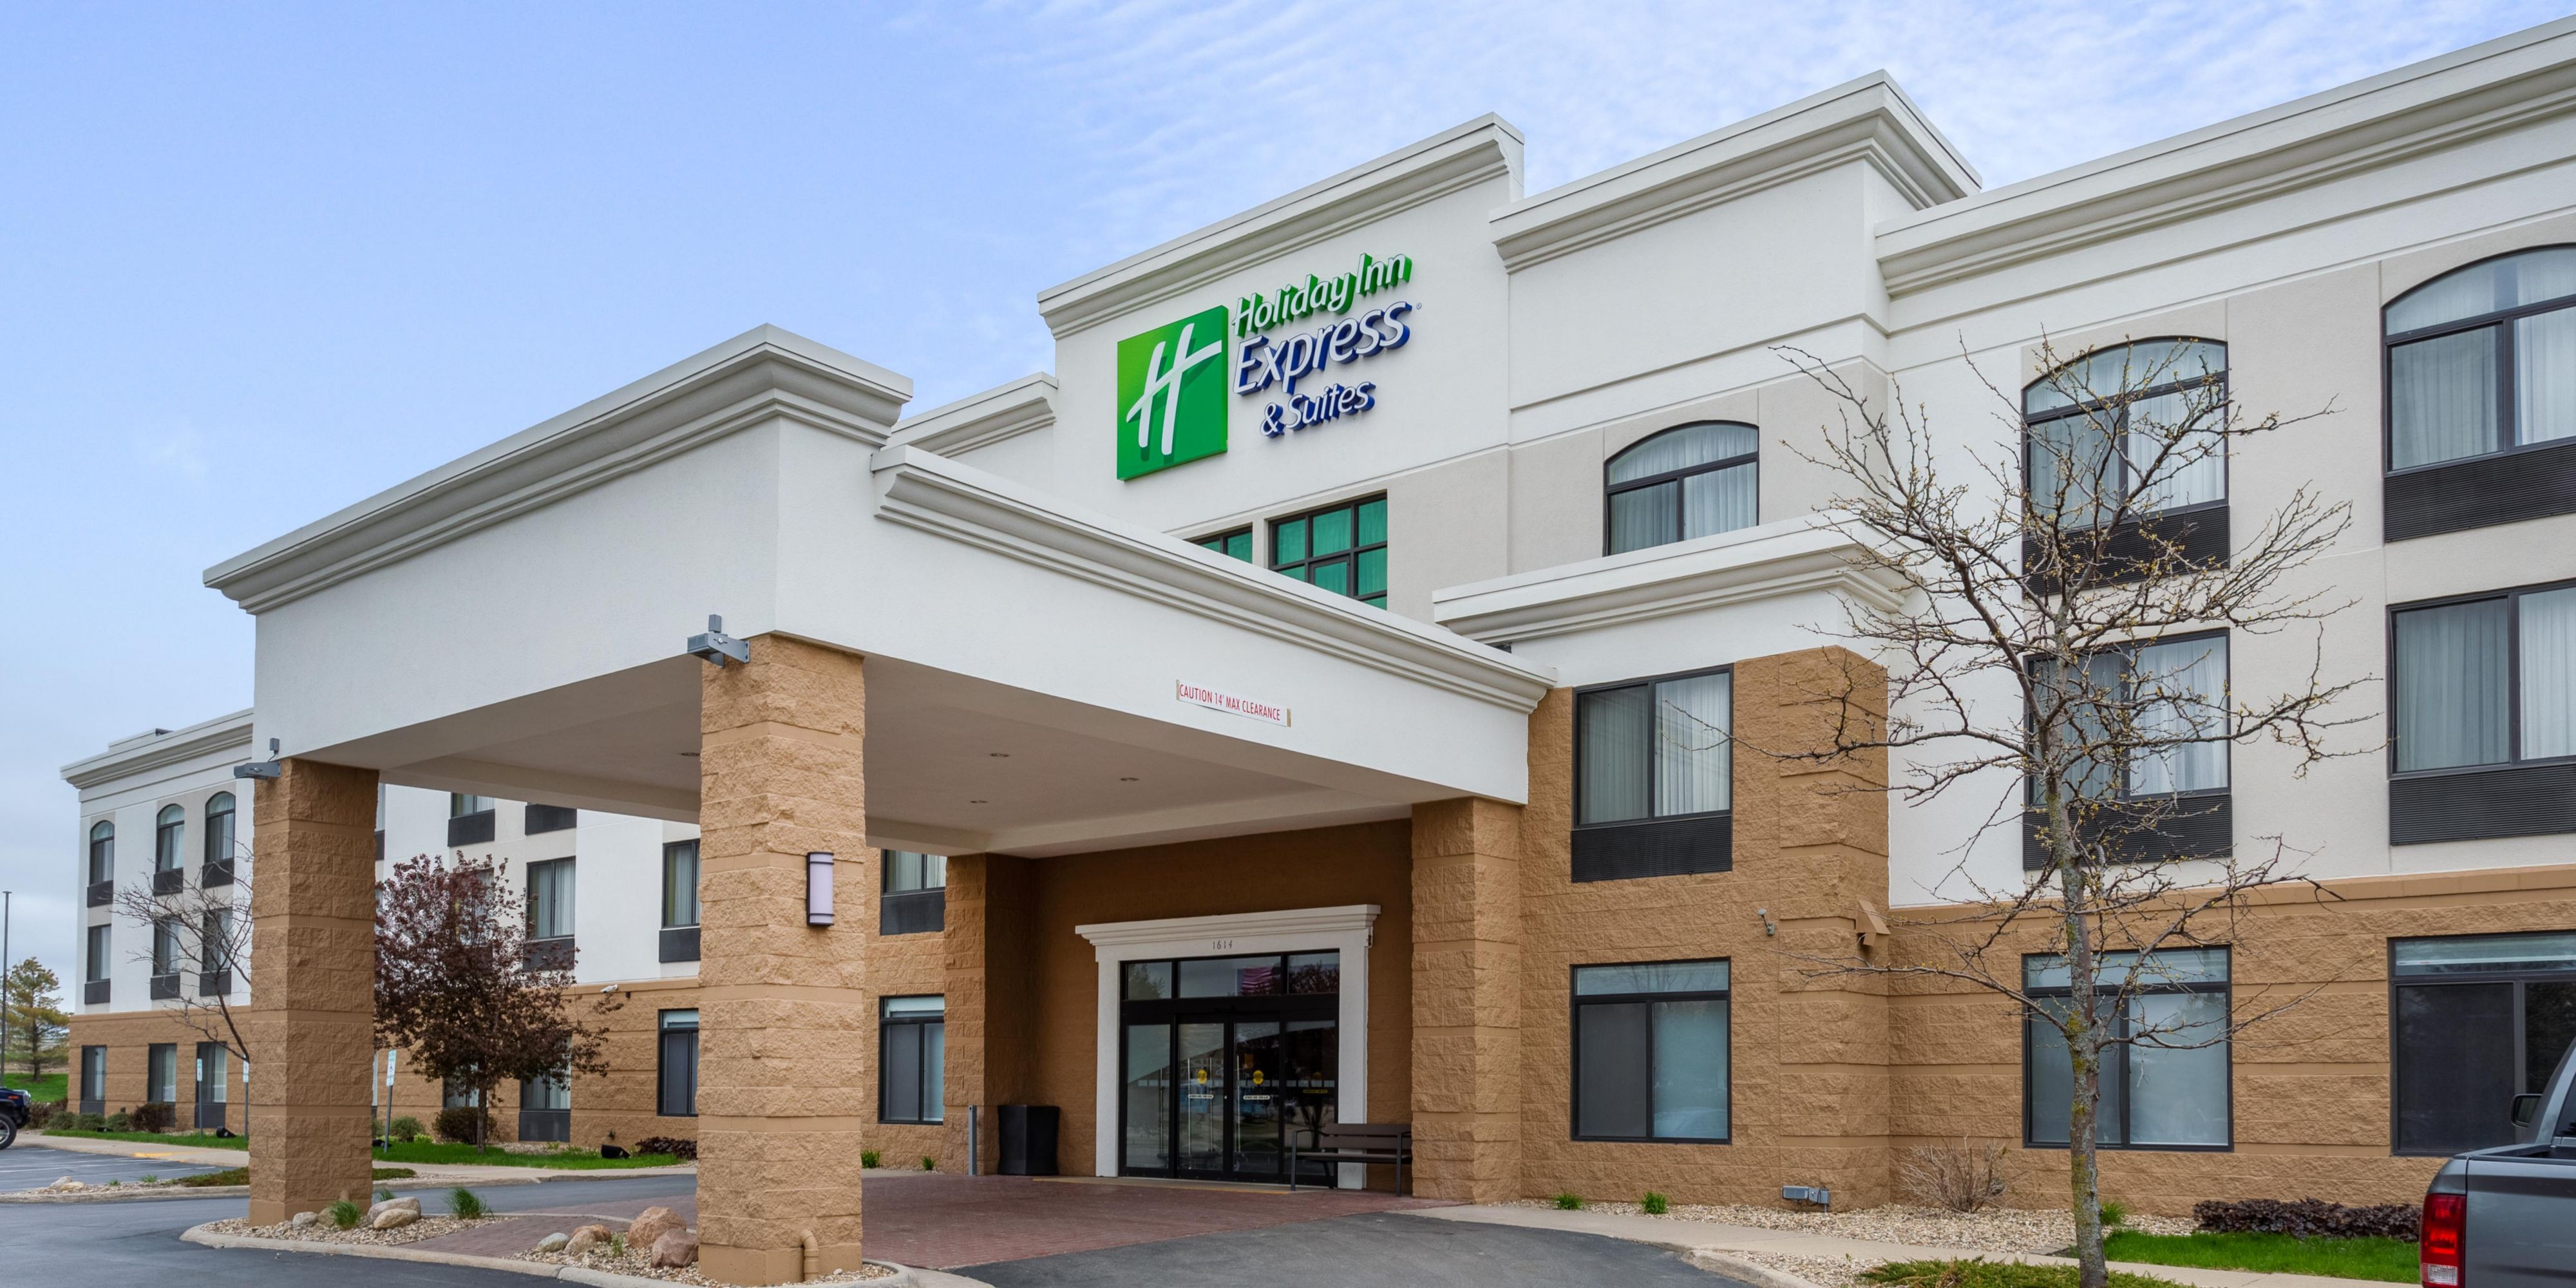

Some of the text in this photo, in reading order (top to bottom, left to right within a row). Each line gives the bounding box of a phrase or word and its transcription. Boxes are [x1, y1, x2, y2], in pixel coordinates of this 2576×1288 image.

[1232, 252, 1412, 337] Holiday Inn
[1233, 301, 1413, 395] Express
[1260, 381, 1377, 439] & Suites
[1179, 684, 1281, 721] CAUTION 14' MAX CLEARANCE
[1213, 940, 1233, 949] 1614
